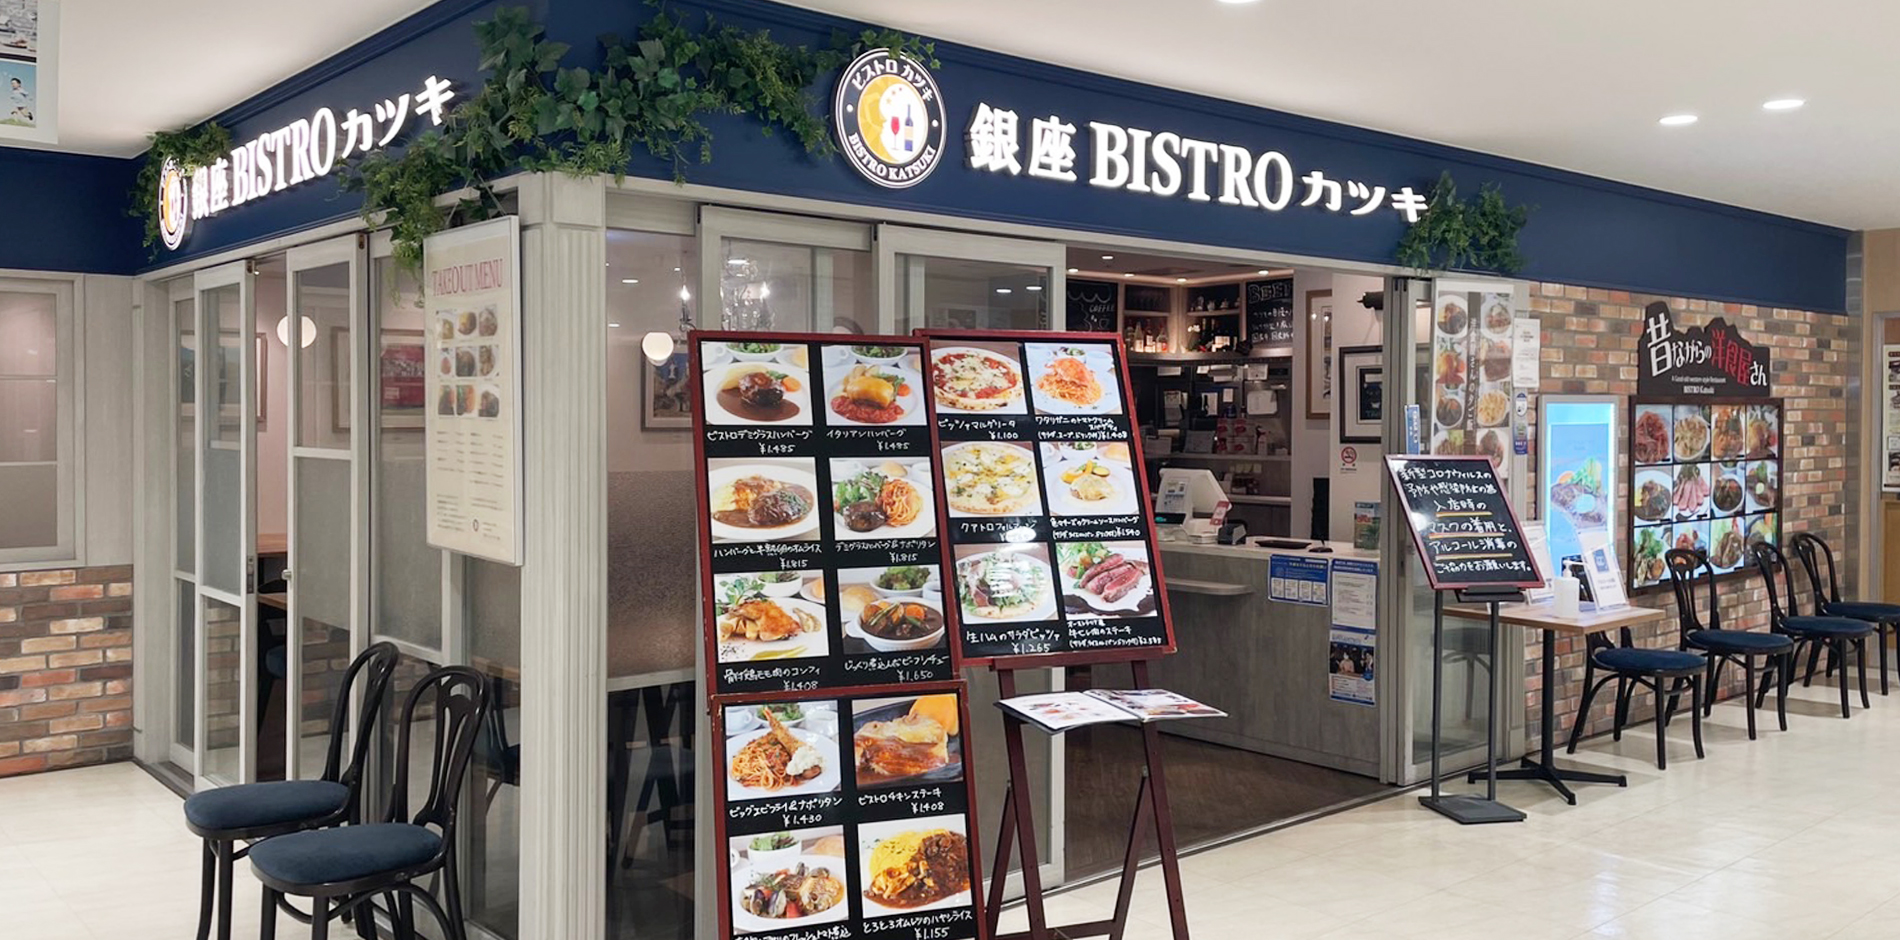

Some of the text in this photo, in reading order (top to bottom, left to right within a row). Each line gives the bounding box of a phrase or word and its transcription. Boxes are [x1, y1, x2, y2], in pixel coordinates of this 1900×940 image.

[851, 58, 934, 102] ビストロ カツキ
[229, 106, 338, 207] BISTRO
[340, 75, 456, 159] カツキ
[848, 131, 937, 181] BISTRO KATSUKI
[968, 101, 1428, 223] 銀座 BISTRO カツキ
[475, 257, 503, 292] MENU
[825, 427, 908, 440] イタリアンハンバーグ
[1433, 497, 1487, 512] 入店時の
[1428, 537, 1518, 555] アルコール消毒の
[857, 787, 942, 807] ビストロチキンステーキ
[862, 909, 973, 935] とろとろオムレツのハヤシライス
